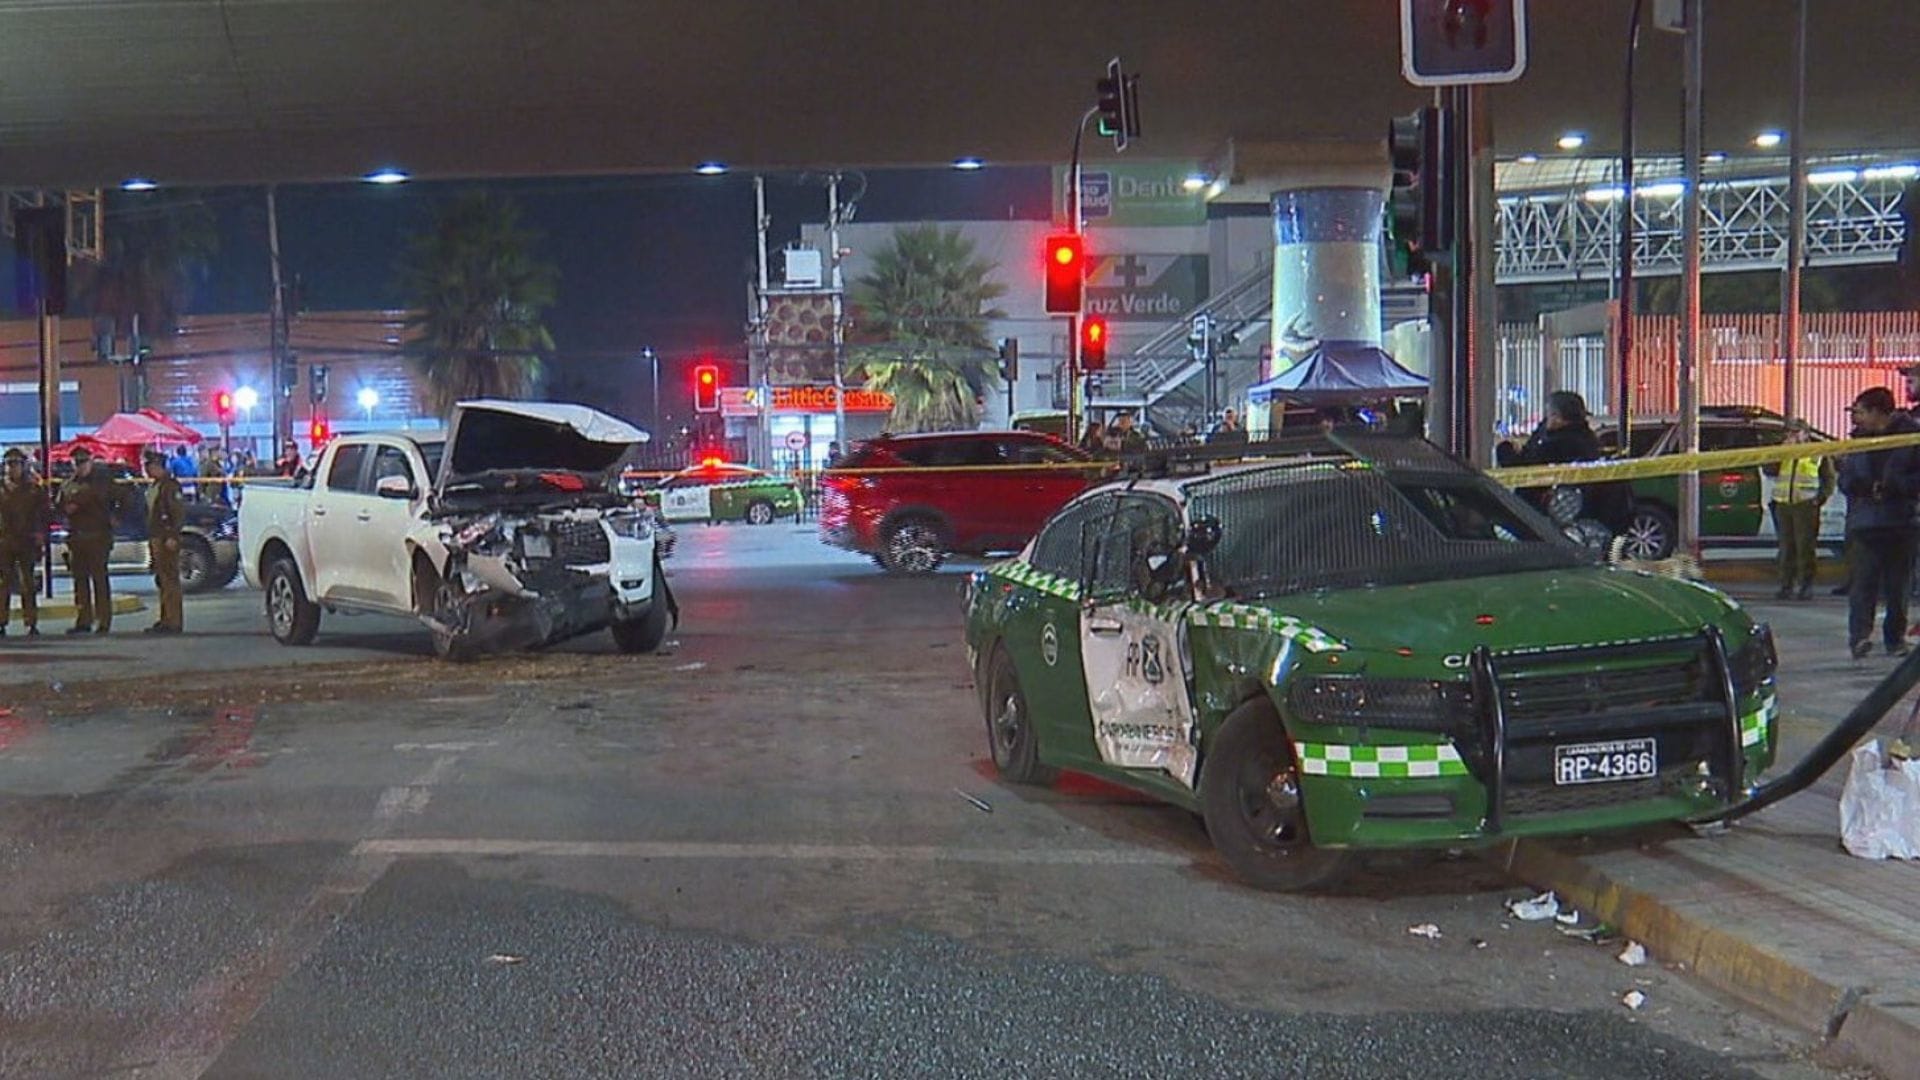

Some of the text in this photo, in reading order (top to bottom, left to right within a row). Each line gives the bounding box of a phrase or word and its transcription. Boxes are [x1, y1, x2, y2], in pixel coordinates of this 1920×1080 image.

[1087, 292, 1181, 314] ruz Verde
[773, 386, 824, 407] Little
